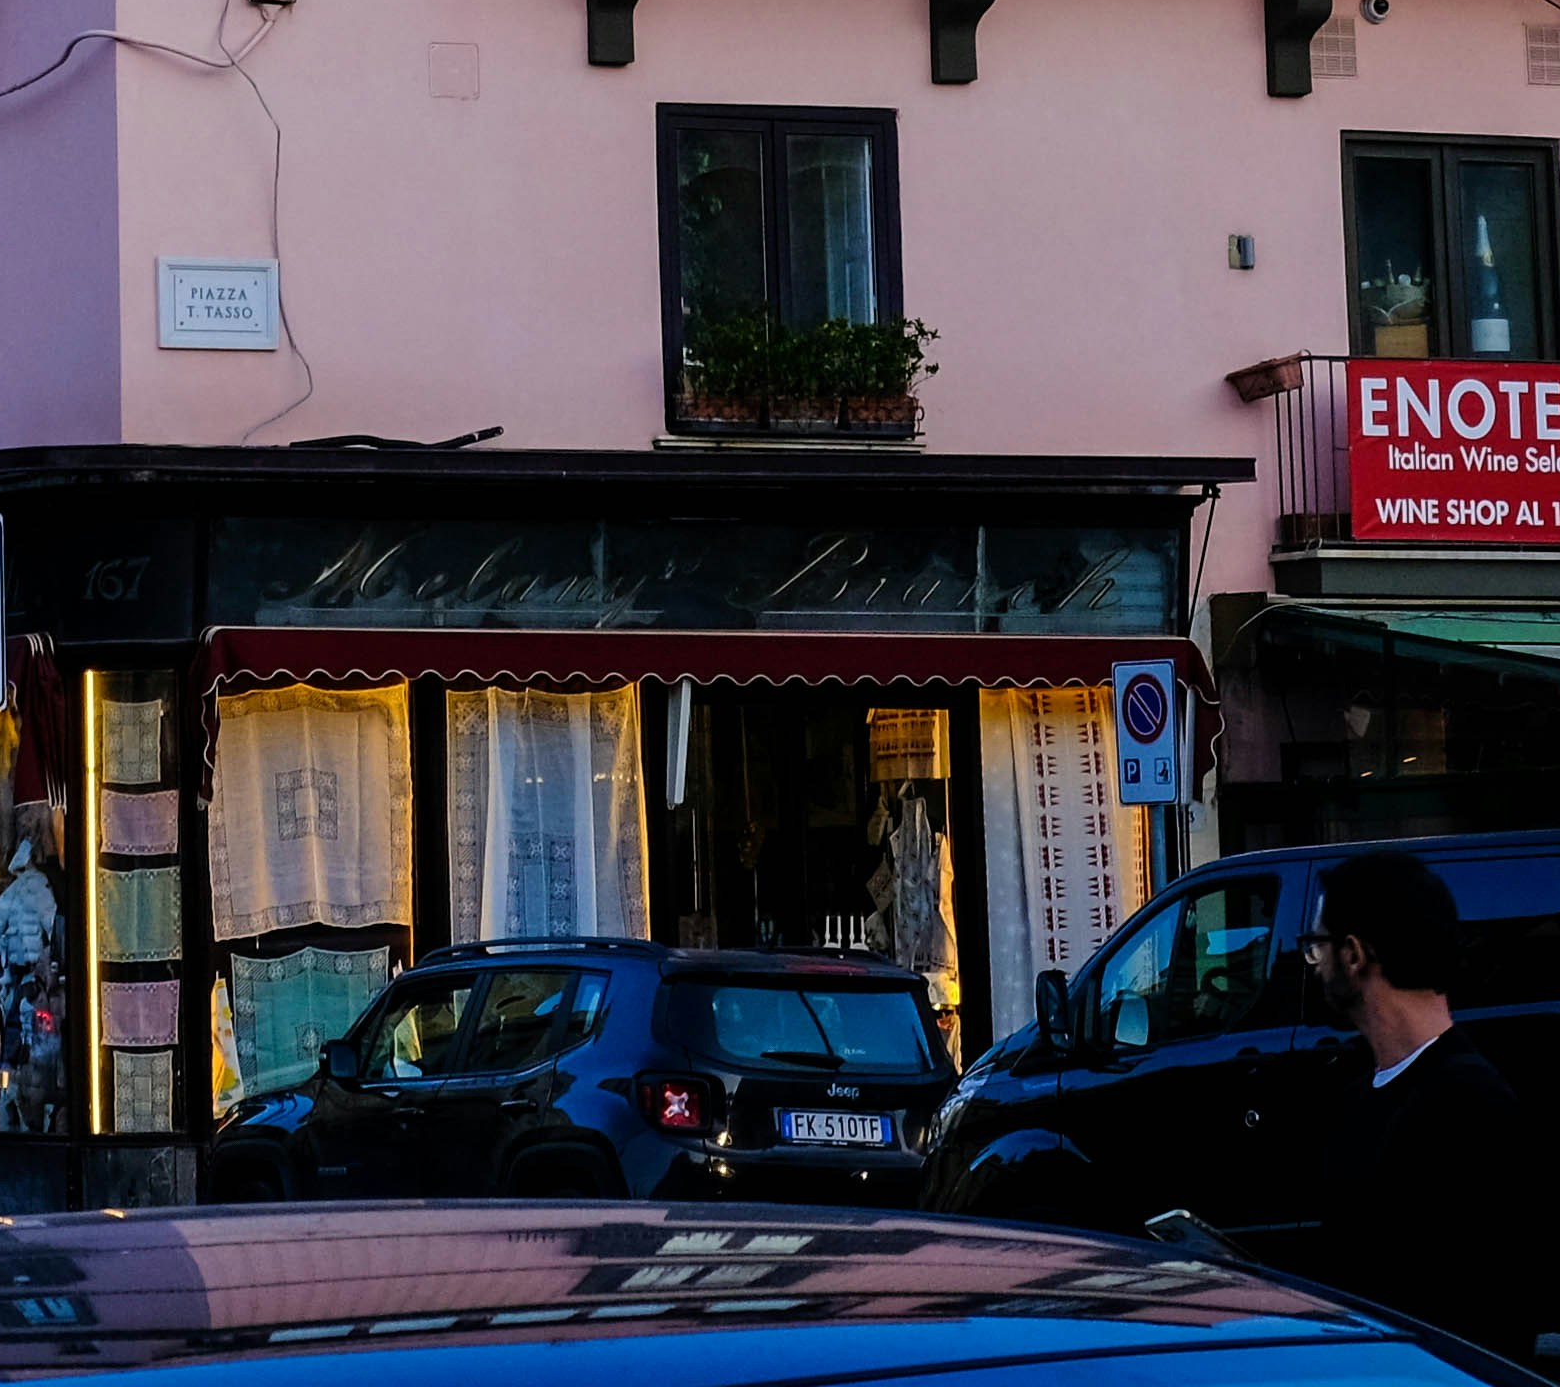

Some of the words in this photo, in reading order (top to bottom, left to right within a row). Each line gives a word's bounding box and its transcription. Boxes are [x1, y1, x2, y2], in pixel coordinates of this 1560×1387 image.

[190, 287, 248, 301] PIAZZA
[186, 305, 200, 319] T.
[205, 306, 254, 320] TASSO
[1388, 443, 1454, 472] Italian
[1460, 445, 1520, 473] Wine
[1375, 498, 1440, 525] WINE
[1446, 499, 1510, 526] SHOP
[1515, 501, 1544, 527] AL
[80, 554, 152, 604] 167
[826, 1082, 861, 1099] Jeep
[794, 1114, 817, 1137] FK
[824, 1116, 879, 1140] 510TF
